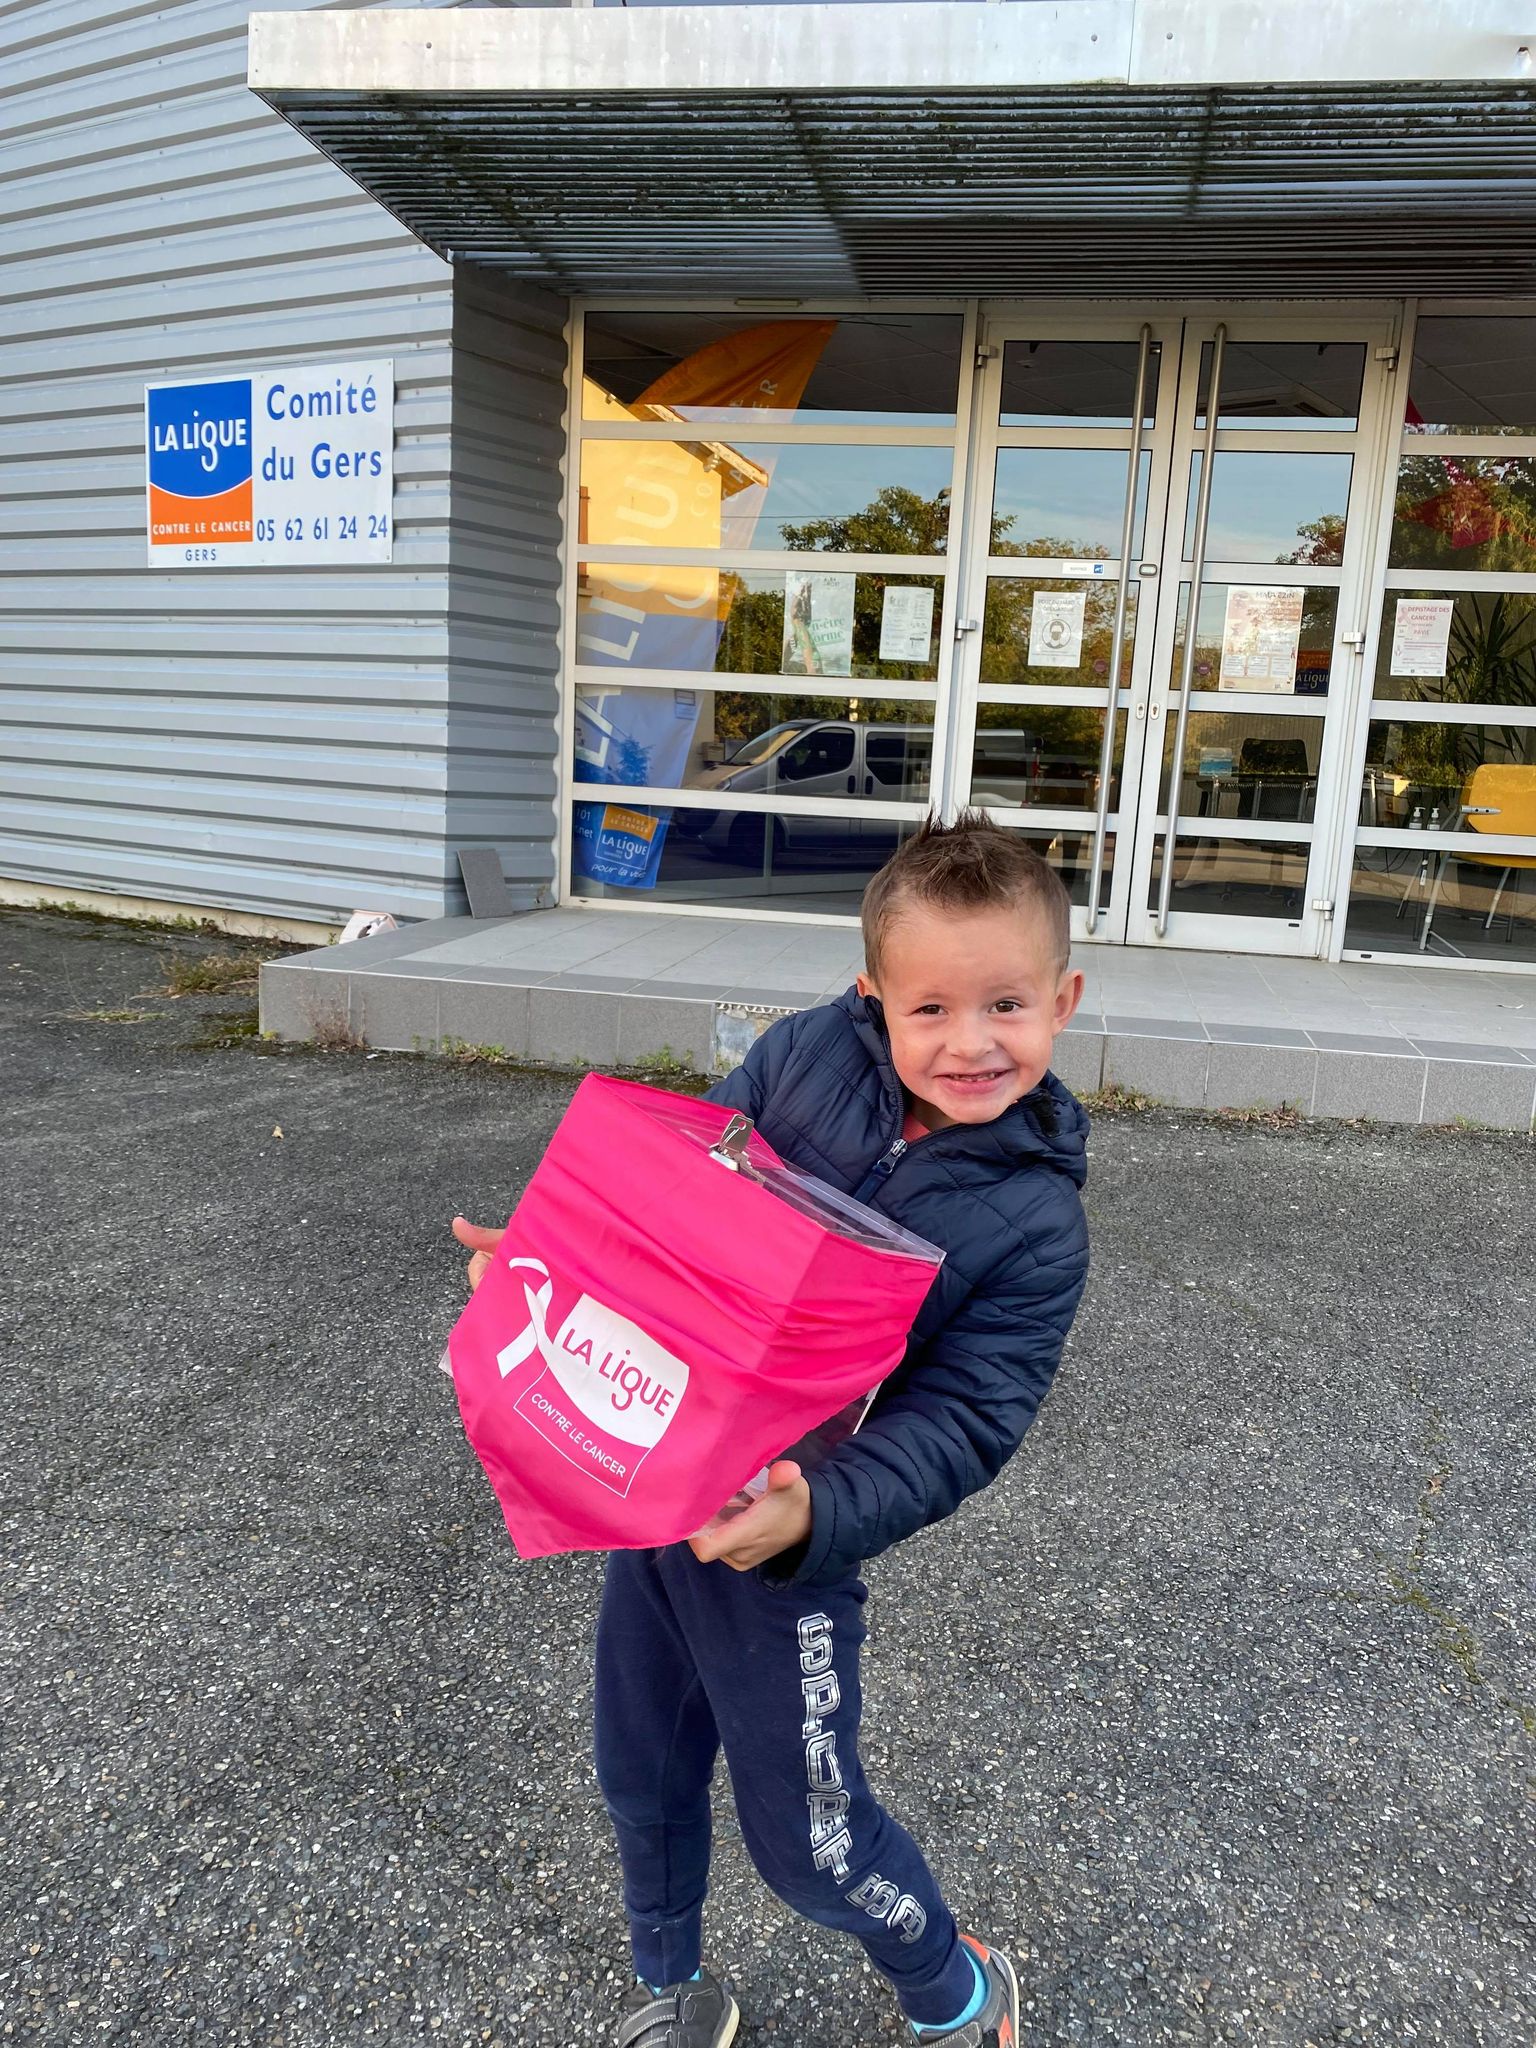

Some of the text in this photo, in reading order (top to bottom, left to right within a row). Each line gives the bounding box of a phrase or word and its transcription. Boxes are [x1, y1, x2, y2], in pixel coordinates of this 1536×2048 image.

[266, 375, 377, 421] Comité
[154, 423, 179, 452] LA
[262, 442, 383, 482] du Gers
[152, 520, 252, 536] CONTRE LE CANCER
[256, 514, 388, 542] 05 62 61 24 24
[185, 548, 217, 562] GERS
[813, 631, 844, 642] orme
[601, 834, 615, 847] LA
[591, 863, 617, 874] pour
[618, 867, 628, 877] la
[561, 1328, 593, 1366] LA
[531, 1393, 627, 1478] CONTRE LE CANCER
